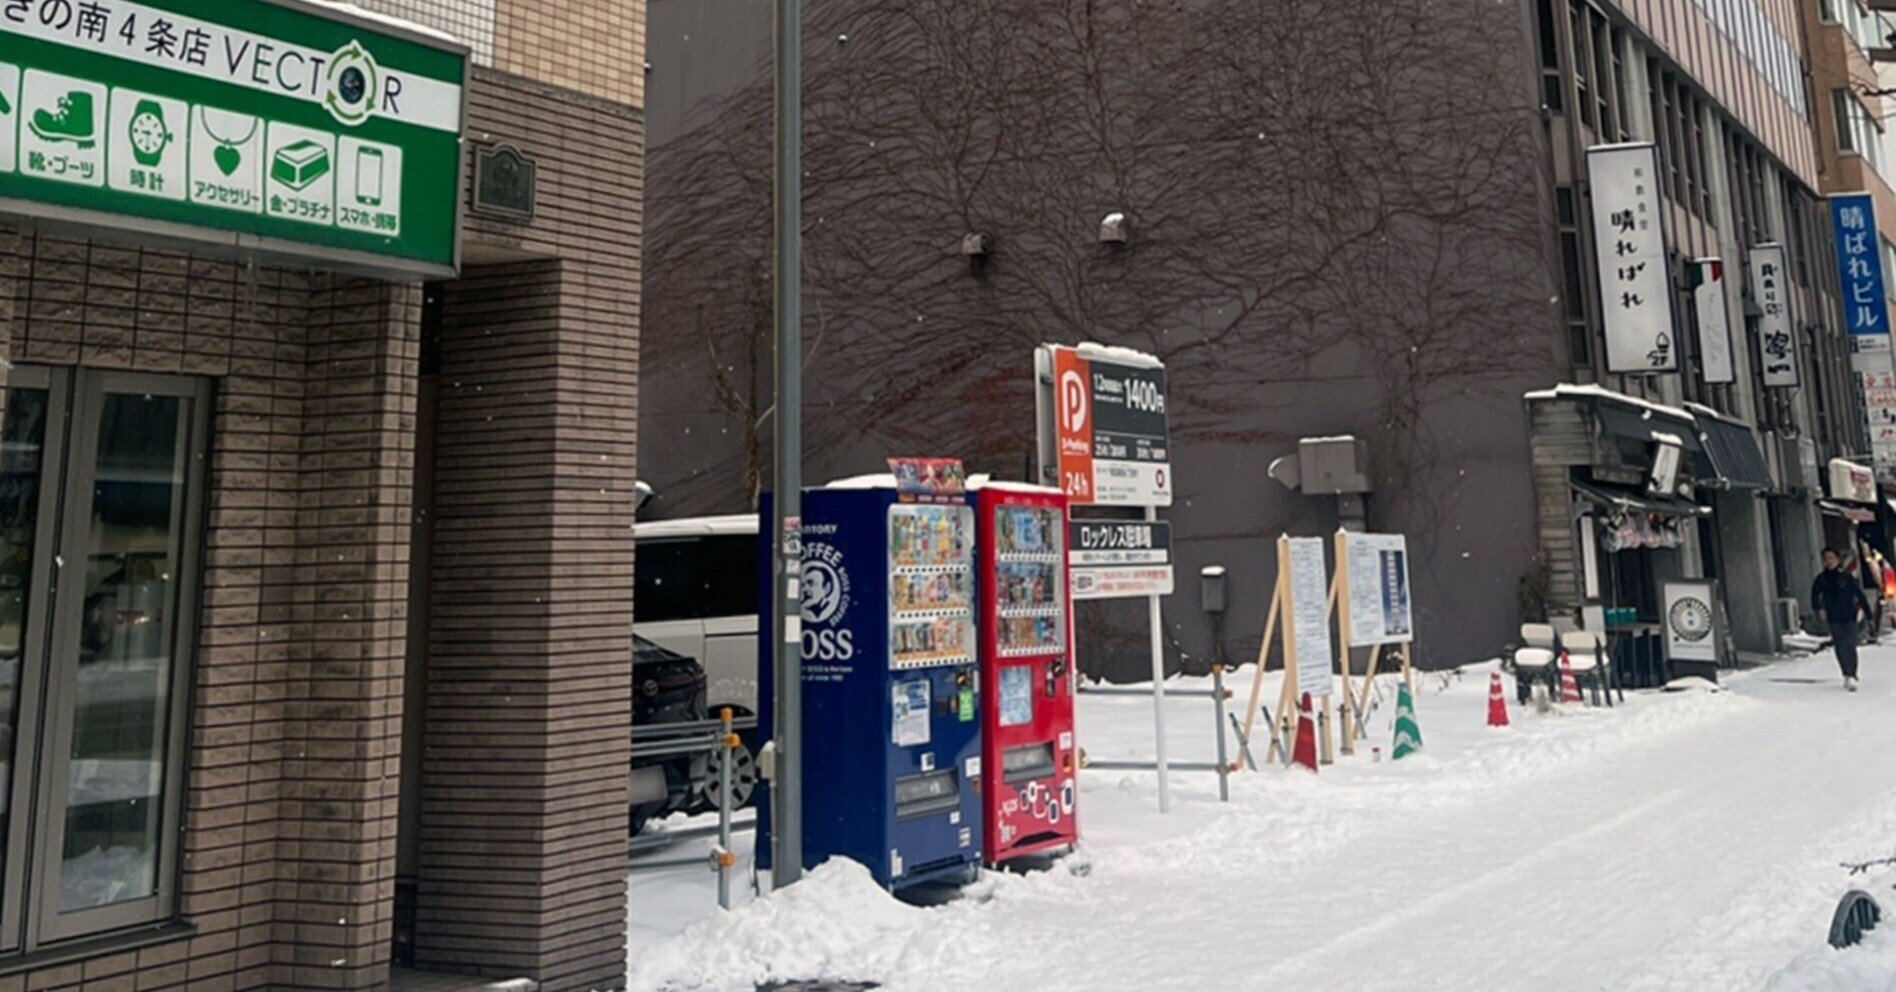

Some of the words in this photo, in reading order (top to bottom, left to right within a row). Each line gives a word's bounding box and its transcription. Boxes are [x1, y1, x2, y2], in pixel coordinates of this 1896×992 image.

[130, 169, 165, 192] 時計
[194, 181, 260, 206] アクセサリー
[269, 194, 331, 219] 金・プラチナ
[340, 207, 397, 231] スマホ・携帯
[1611, 209, 1646, 309] 晴ればれ
[1839, 206, 1879, 328] 晴ればれビル
[1065, 472, 1089, 496] 24h
[1081, 525, 1152, 548] ロックレス駐車場
[800, 542, 843, 567] OFFEE
[800, 629, 854, 661] OSS
